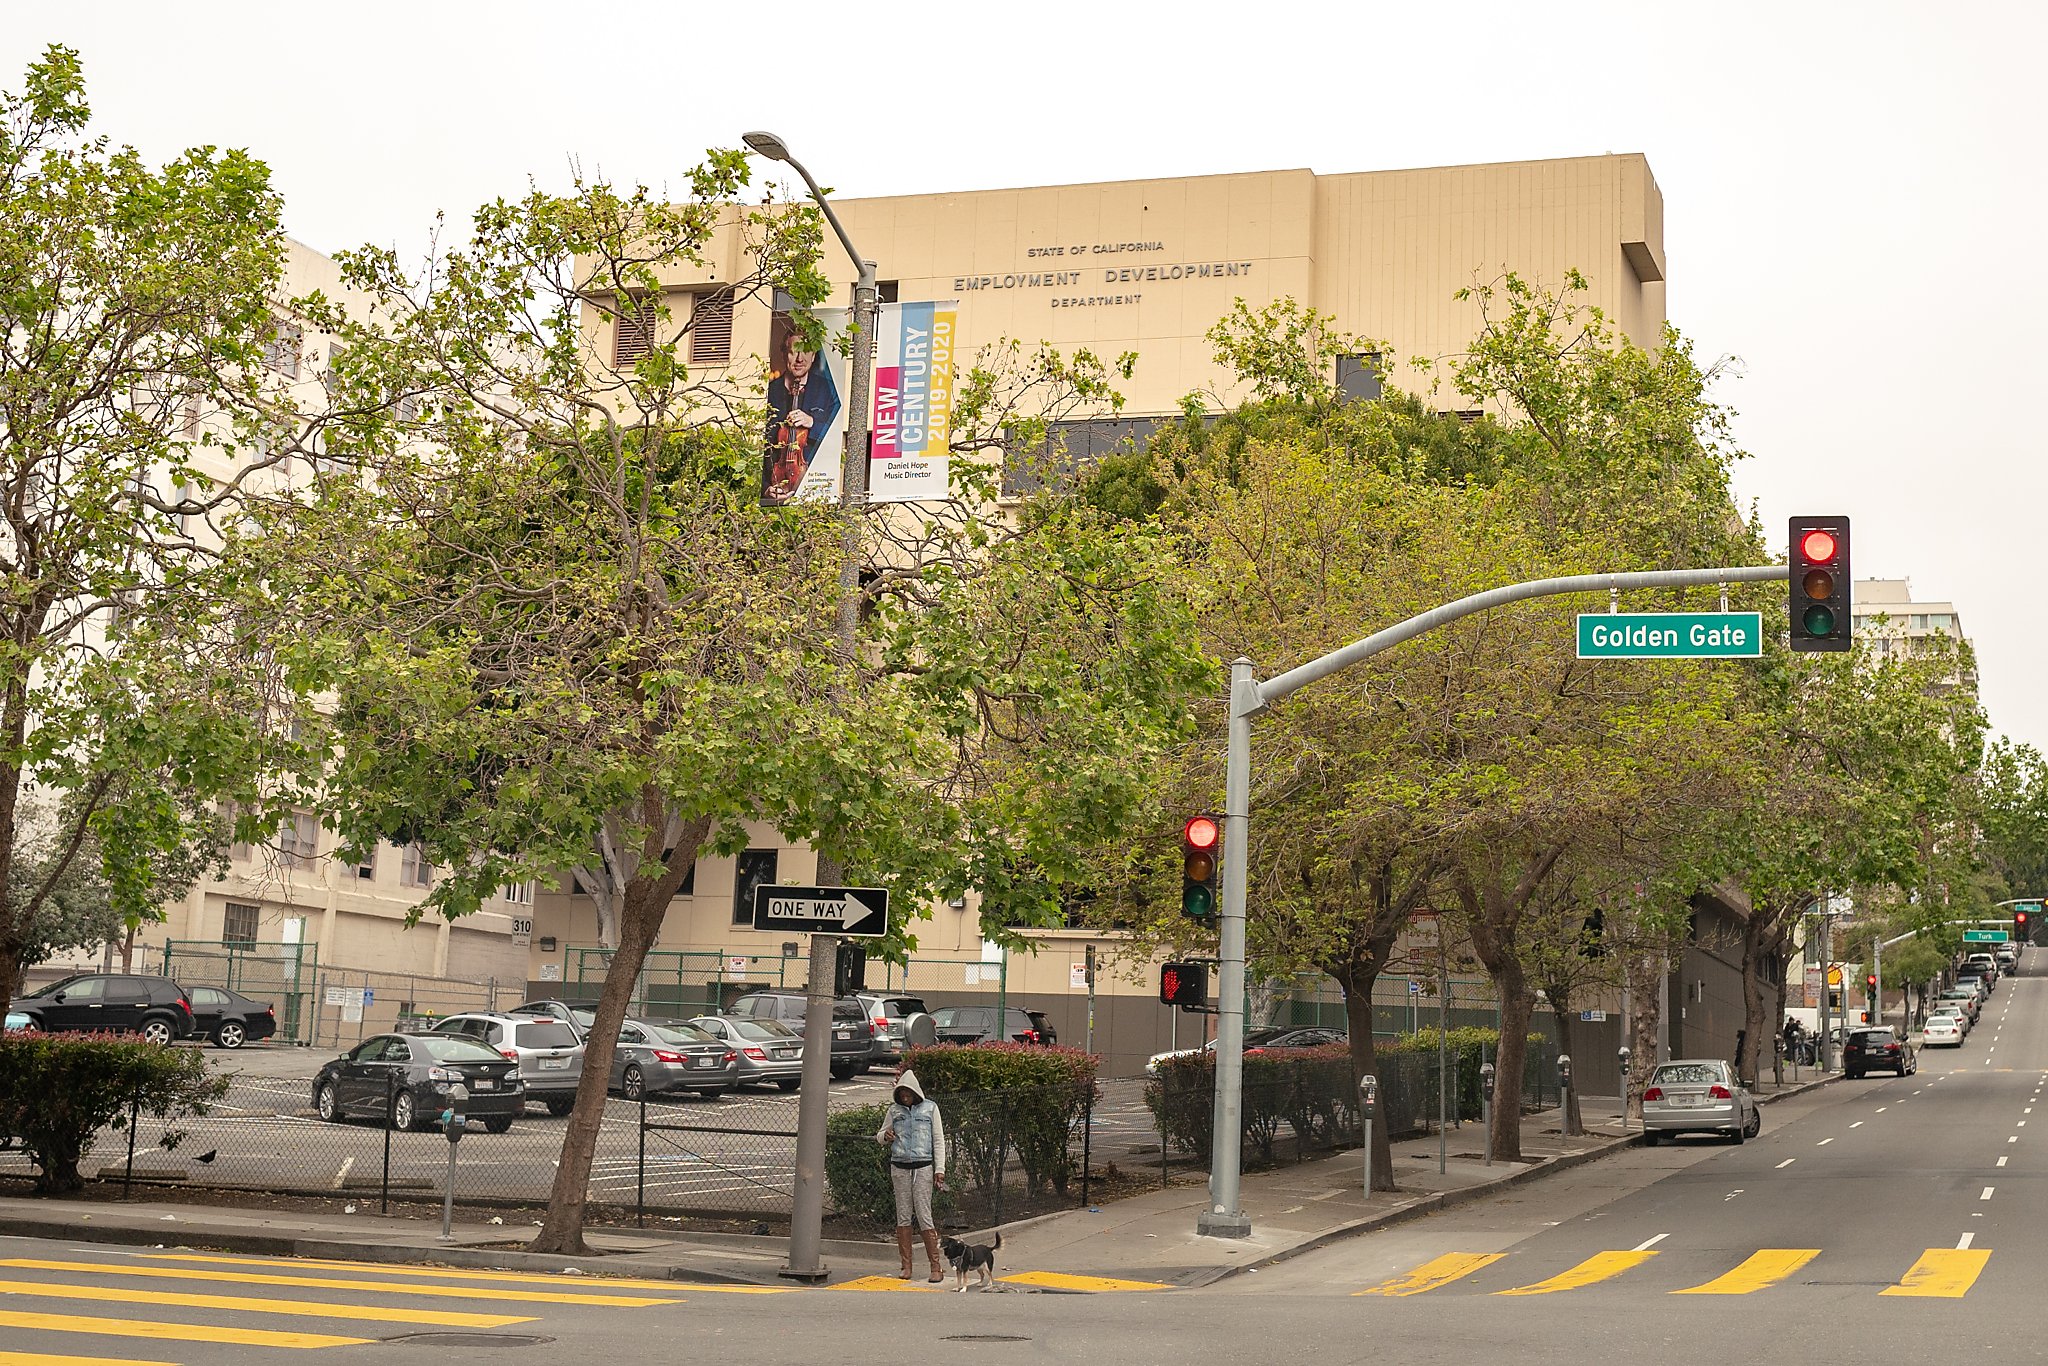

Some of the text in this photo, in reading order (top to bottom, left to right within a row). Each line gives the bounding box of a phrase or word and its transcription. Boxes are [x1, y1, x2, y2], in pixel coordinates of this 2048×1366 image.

[1028, 241, 1164, 258] STATE OF CALIFORNIA
[954, 262, 1252, 291] EMPLOYMENT DEVELOPMENT
[1051, 294, 1142, 308] DEPARTMENT
[901, 327, 928, 444] CENTURY
[928, 321, 950, 442] 2019-2020
[876, 387, 899, 445] NEW
[887, 462, 929, 470] Daniel Hope
[904, 471, 931, 479] Director
[1592, 624, 1746, 647] Golden Gate
[772, 901, 847, 918] ONE WAY
[514, 920, 531, 932] 310
